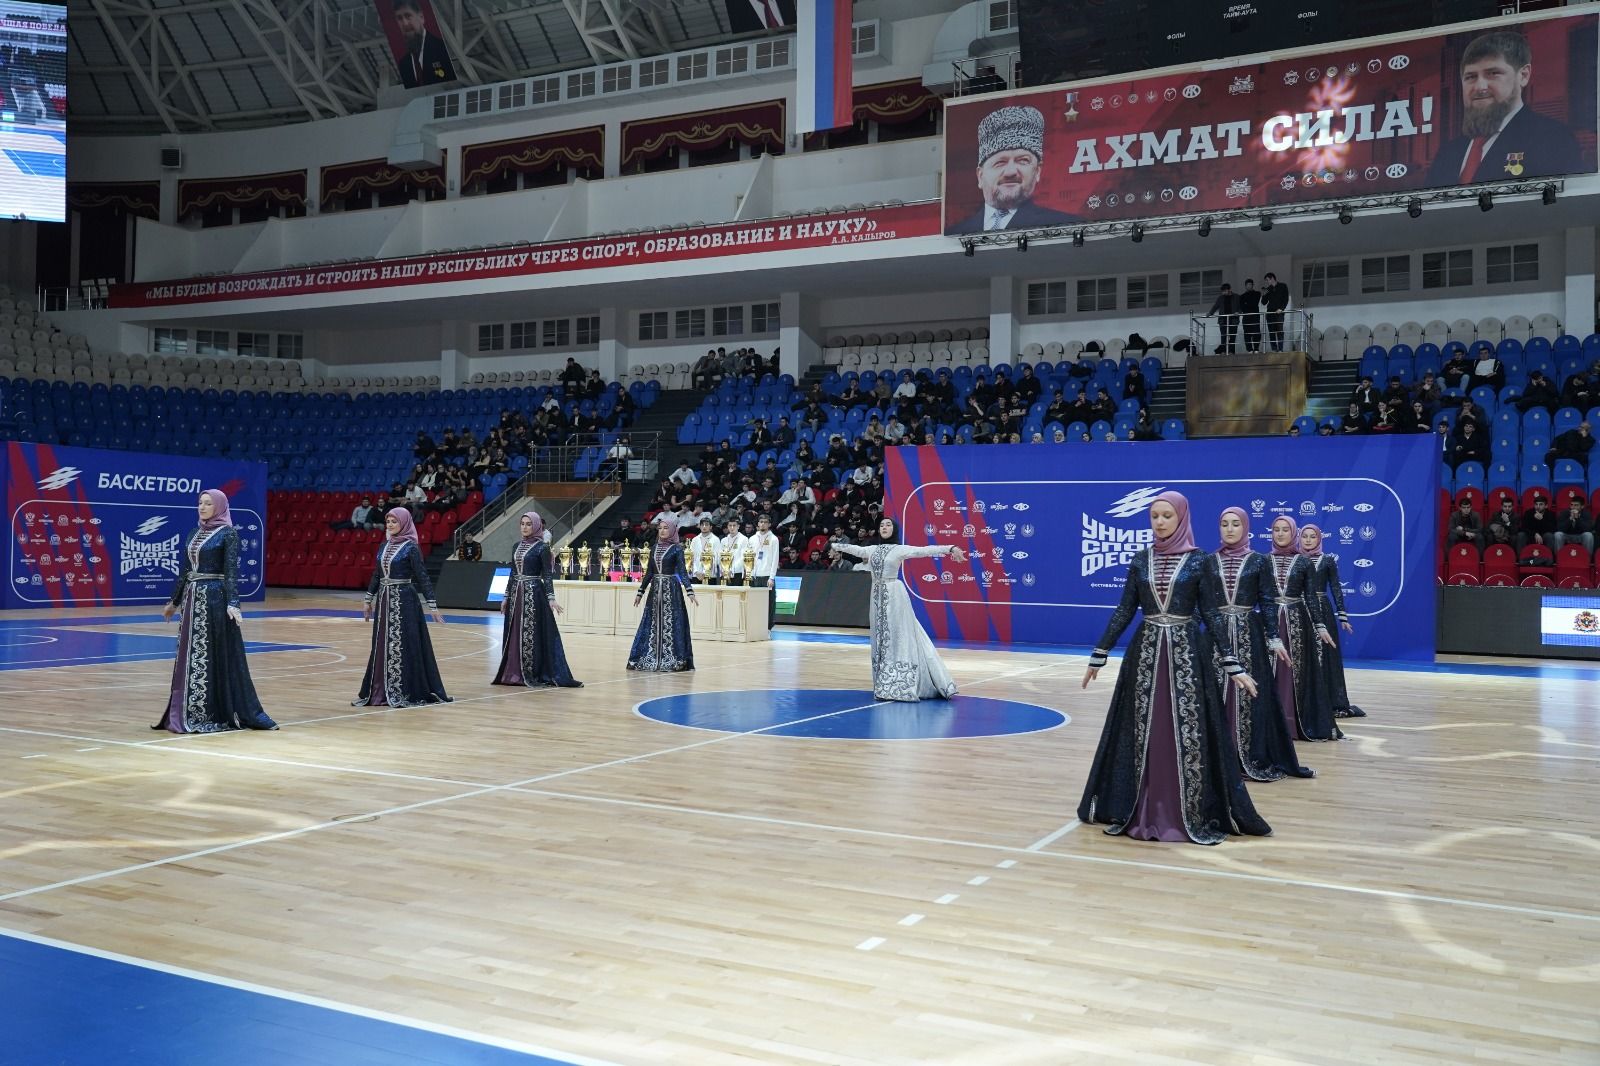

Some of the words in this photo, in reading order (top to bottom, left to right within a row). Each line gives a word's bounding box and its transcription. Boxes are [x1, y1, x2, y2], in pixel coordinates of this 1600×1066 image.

[1228, 3, 1251, 12] ВРЕМЯ
[1297, 10, 1318, 19] ФОЛЫ
[1167, 32, 1186, 40] ФОЛЫ
[1068, 120, 1251, 174] АХМАТ
[1262, 96, 1433, 152] СИЛА!
[831, 235, 850, 245] А.А.
[851, 230, 896, 243] КАДЫРОВ
[146, 287, 174, 300] «МЫ
[176, 282, 216, 297] БУДЕМ
[218, 277, 302, 293] ВОЗРОЖДАТЬ
[305, 274, 314, 286] И
[316, 270, 379, 285] СТРОИТЬ
[380, 264, 425, 280] НАШУ
[427, 252, 529, 276] РЕСПУБЛИКУ
[531, 249, 580, 266] ЧЕРЕЗ
[582, 241, 641, 261] СПОРТ,
[643, 226, 775, 255] ОБРАЗОВАНИЕ
[778, 225, 792, 242] И
[796, 216, 878, 240] НАУКУ»
[97, 472, 202, 494] БАСКЕТБОЛ
[120, 530, 180, 552] УНИВЕР
[1081, 539, 1155, 555] СПО
[120, 549, 180, 561] СПОРТ
[120, 557, 180, 577] ФЕСТ25
